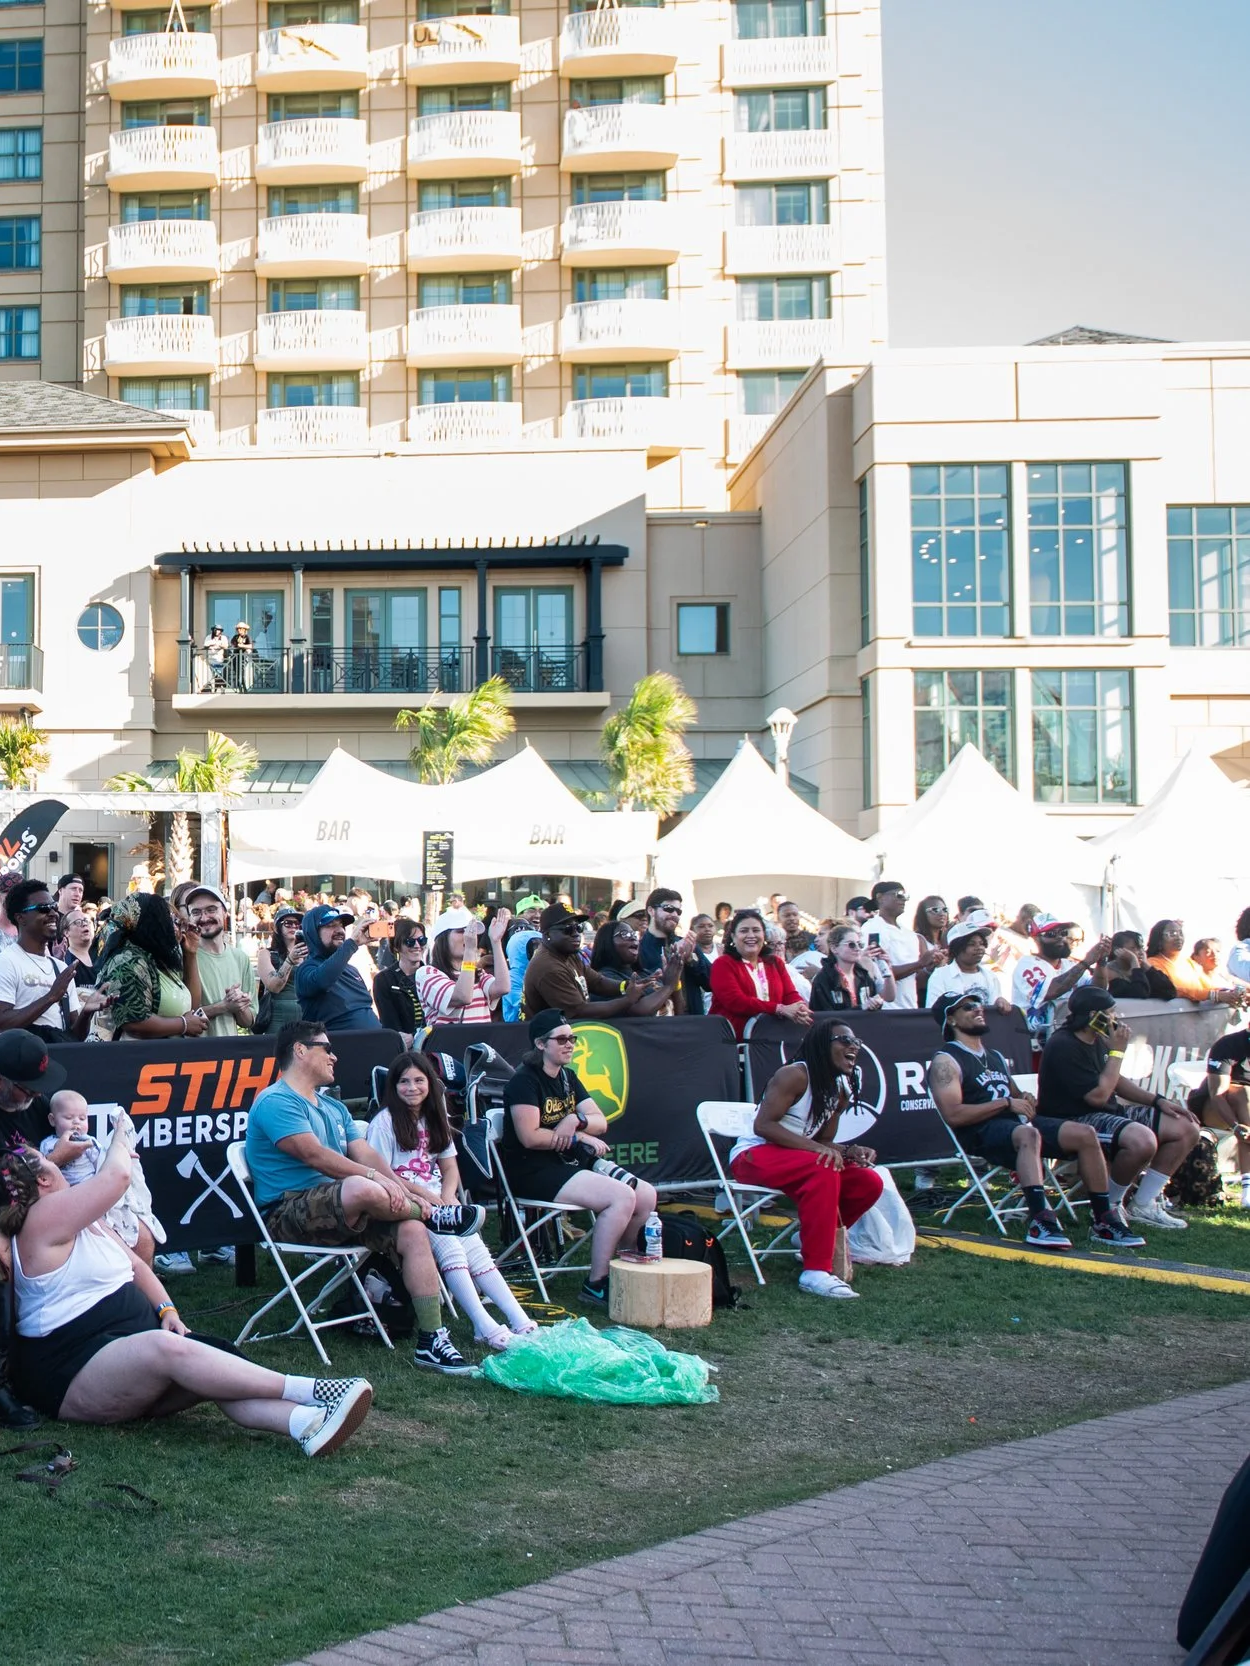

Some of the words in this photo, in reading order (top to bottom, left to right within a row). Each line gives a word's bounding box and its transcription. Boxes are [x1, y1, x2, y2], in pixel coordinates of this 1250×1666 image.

[316, 820, 351, 842] BAR
[529, 824, 566, 845] BAR
[130, 1057, 282, 1116] STIH
